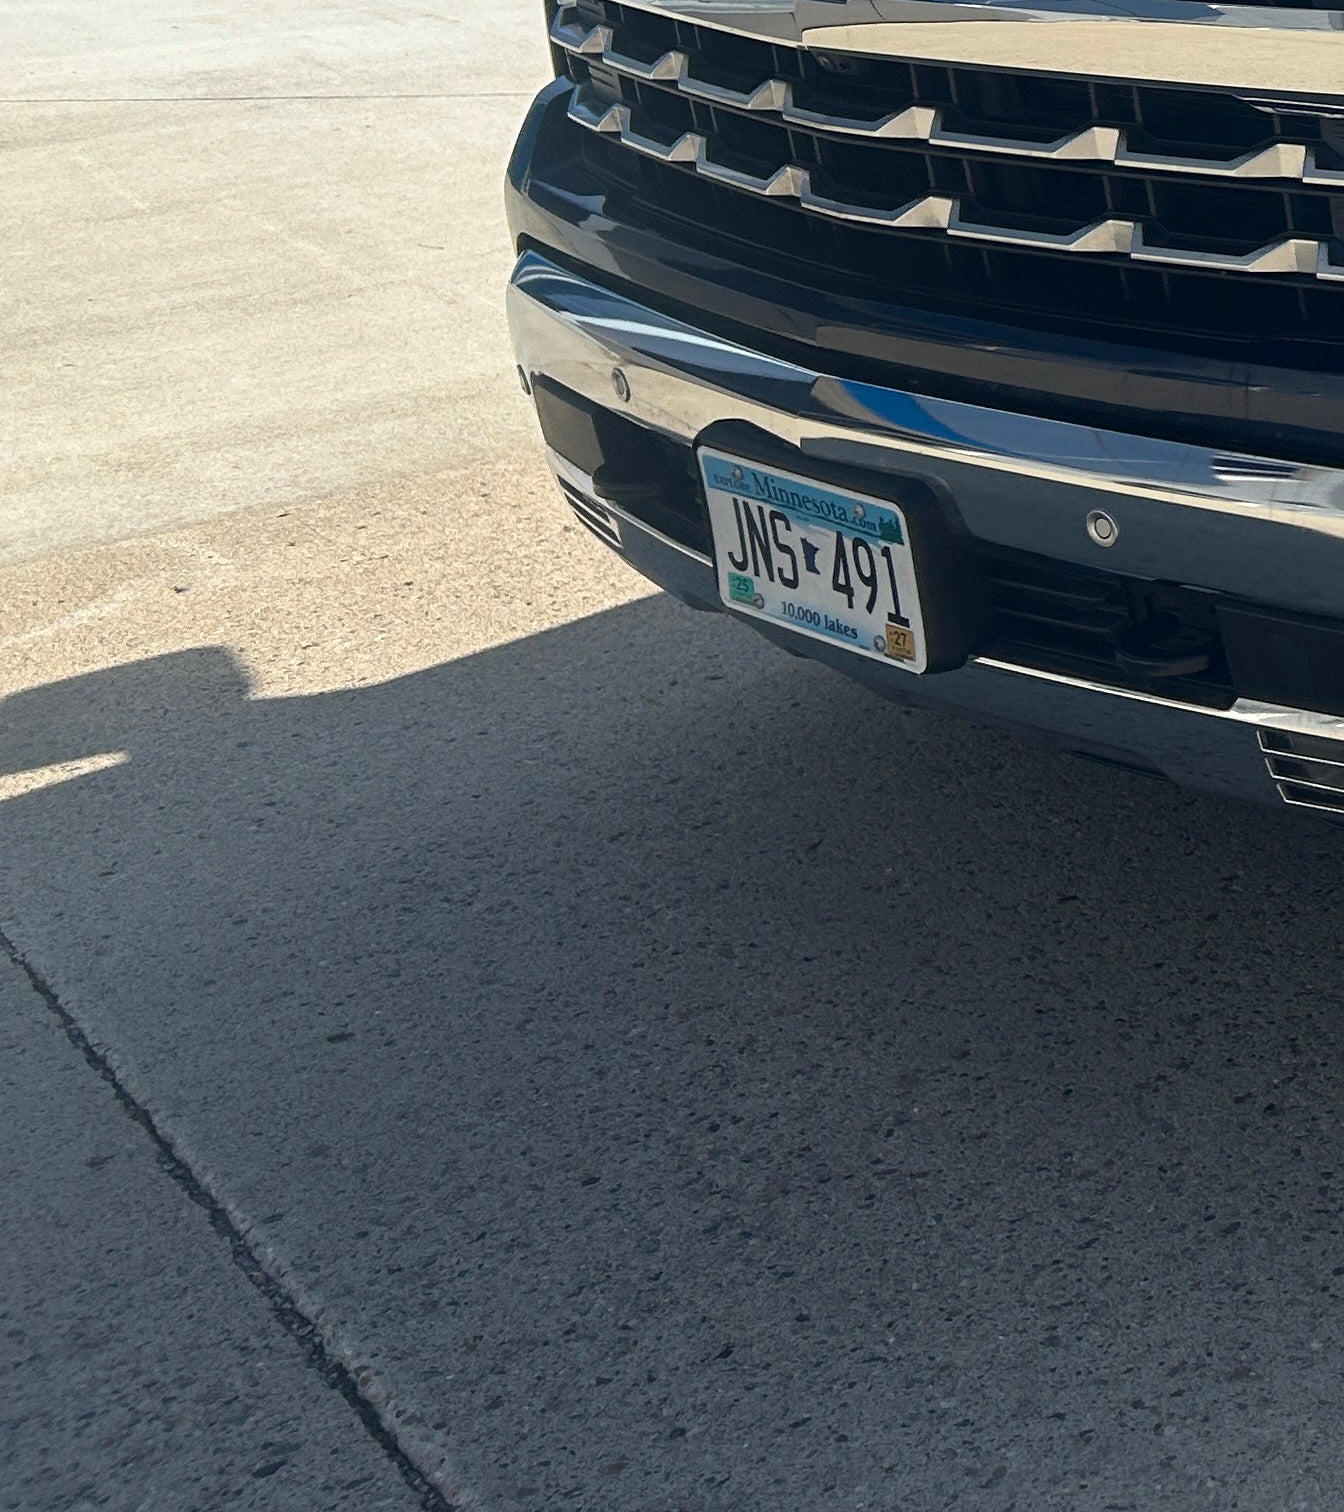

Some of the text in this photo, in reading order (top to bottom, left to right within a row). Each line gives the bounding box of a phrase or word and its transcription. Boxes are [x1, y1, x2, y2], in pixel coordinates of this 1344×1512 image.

[727, 497, 911, 628] JNS 491
[781, 601, 859, 640] 10,000 lakes
